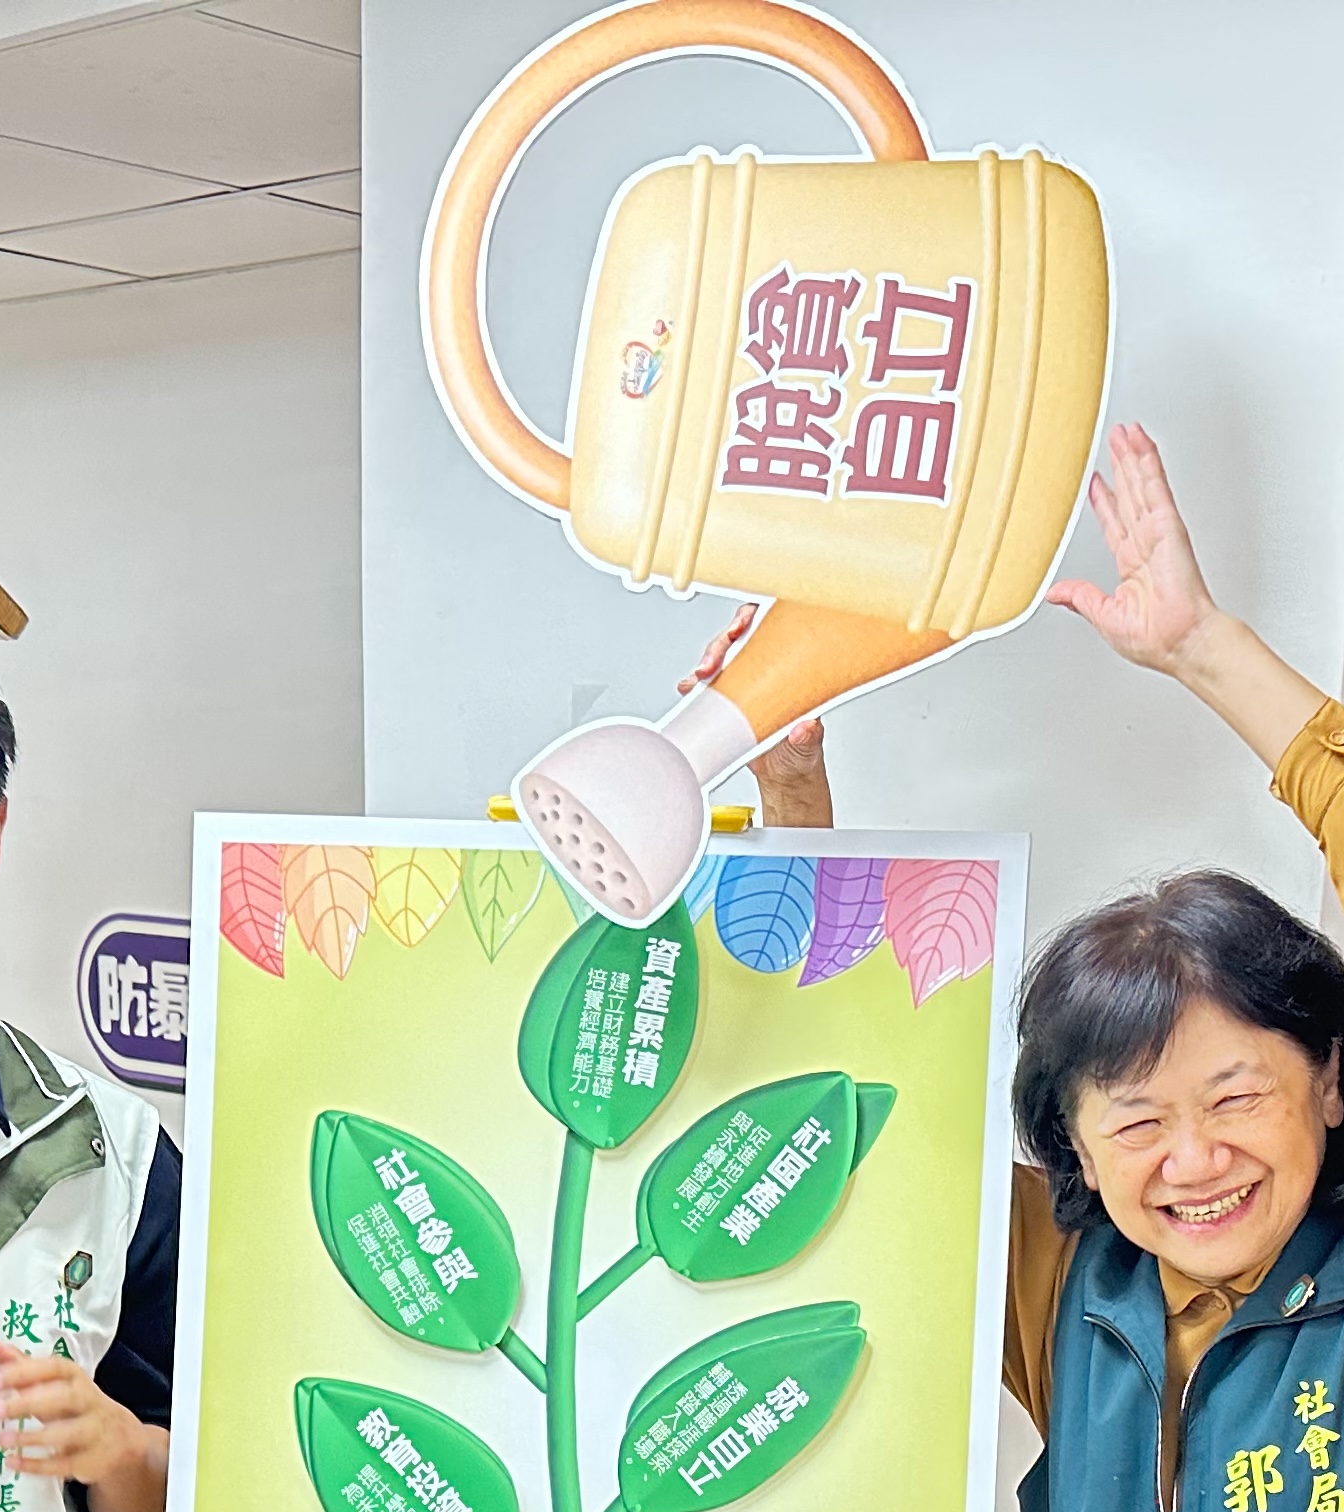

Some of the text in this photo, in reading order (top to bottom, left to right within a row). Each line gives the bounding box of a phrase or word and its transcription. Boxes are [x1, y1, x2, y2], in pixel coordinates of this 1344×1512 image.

[722, 267, 861, 496] 脫貧
[841, 278, 972, 501] 自立
[98, 954, 189, 1041] 防暴
[621, 937, 682, 1088] 資產累積
[373, 1148, 478, 1295] 社會參與
[720, 1116, 831, 1246] 社區產業
[678, 1376, 809, 1496] 就業自立
